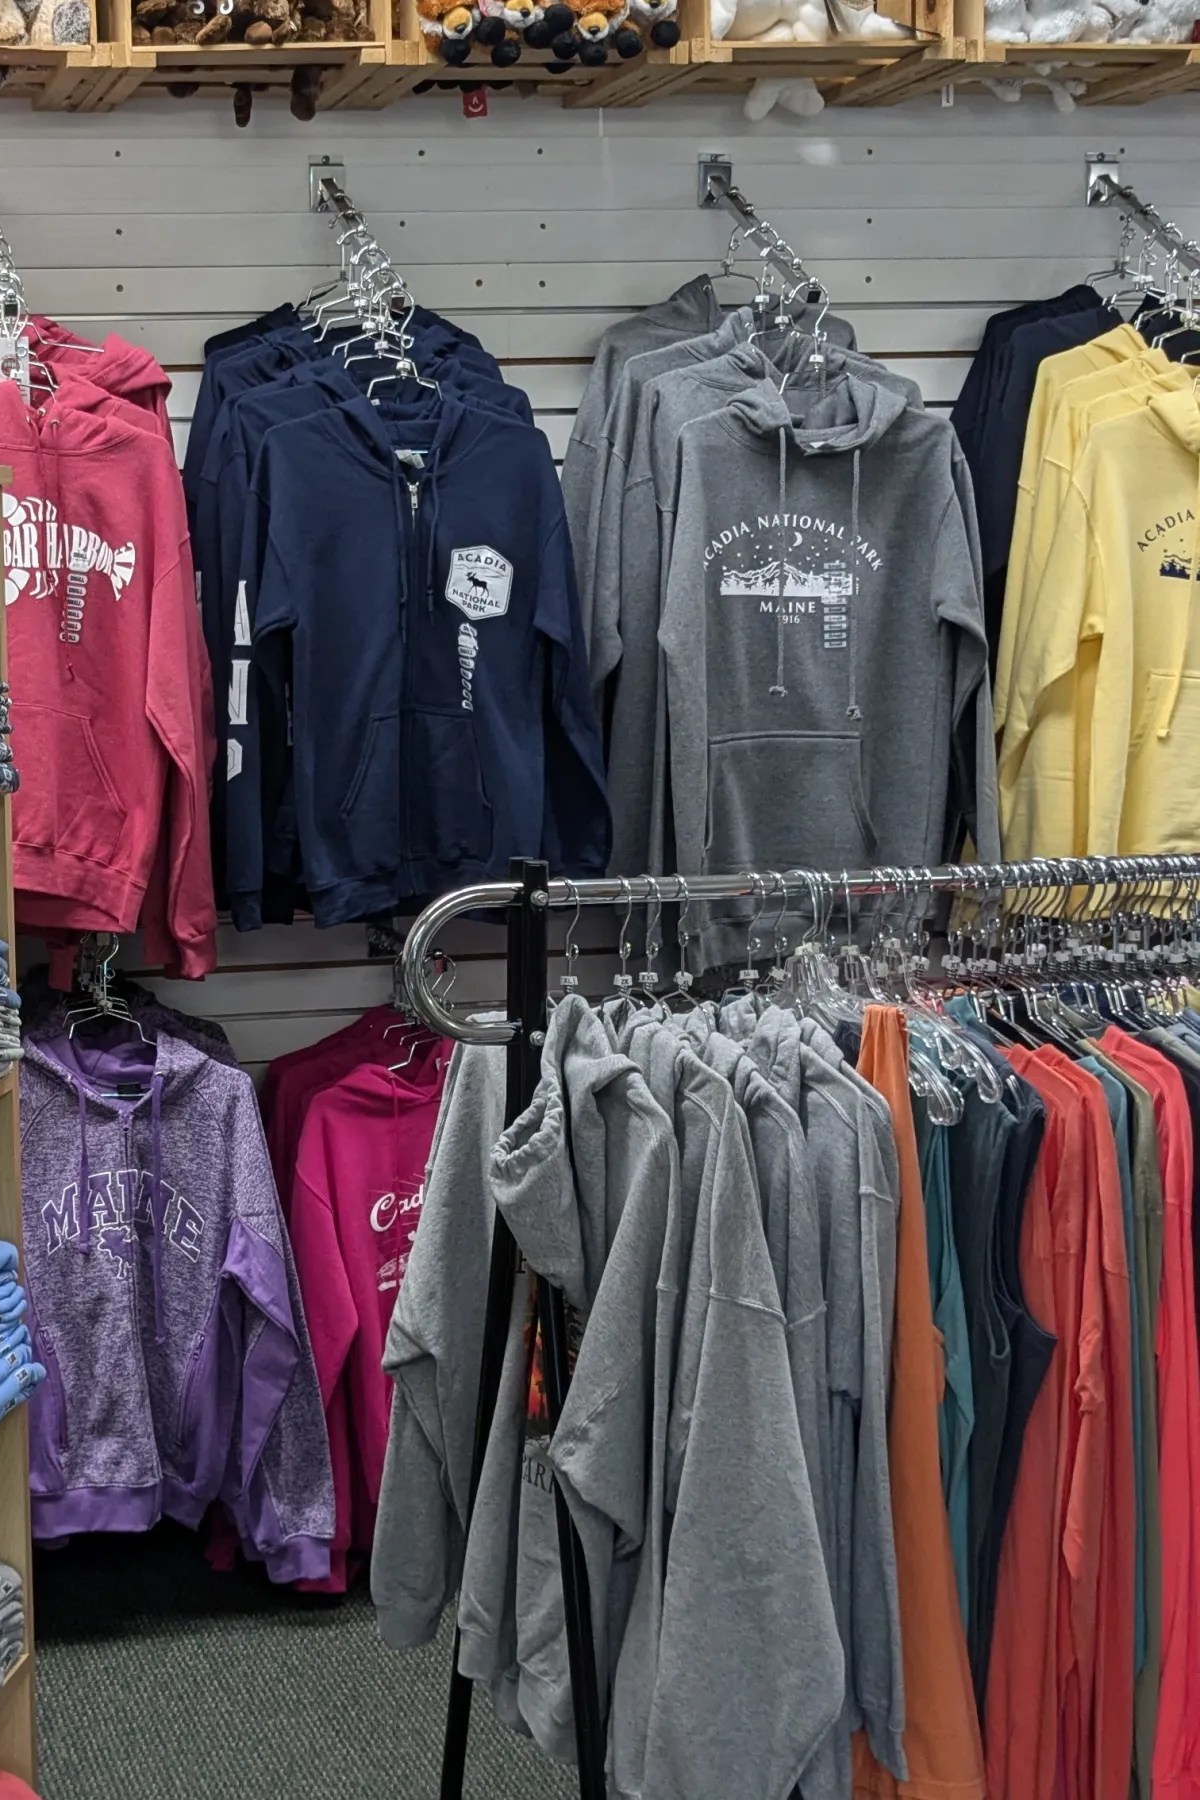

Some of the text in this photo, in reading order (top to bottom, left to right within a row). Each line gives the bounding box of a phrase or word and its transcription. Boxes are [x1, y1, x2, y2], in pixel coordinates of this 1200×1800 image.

[1137, 509, 1195, 552] ACADIA
[3, 522, 114, 577] BAR HARBOR
[703, 514, 883, 572] ACADIA NATIONAL PARK
[457, 553, 506, 572] ACADIA
[453, 588, 501, 609] NATIONAL
[462, 599, 486, 613] PARK
[759, 602, 816, 613] MAINE
[780, 615, 800, 624] 916
[41, 1169, 205, 1263] MAINE
